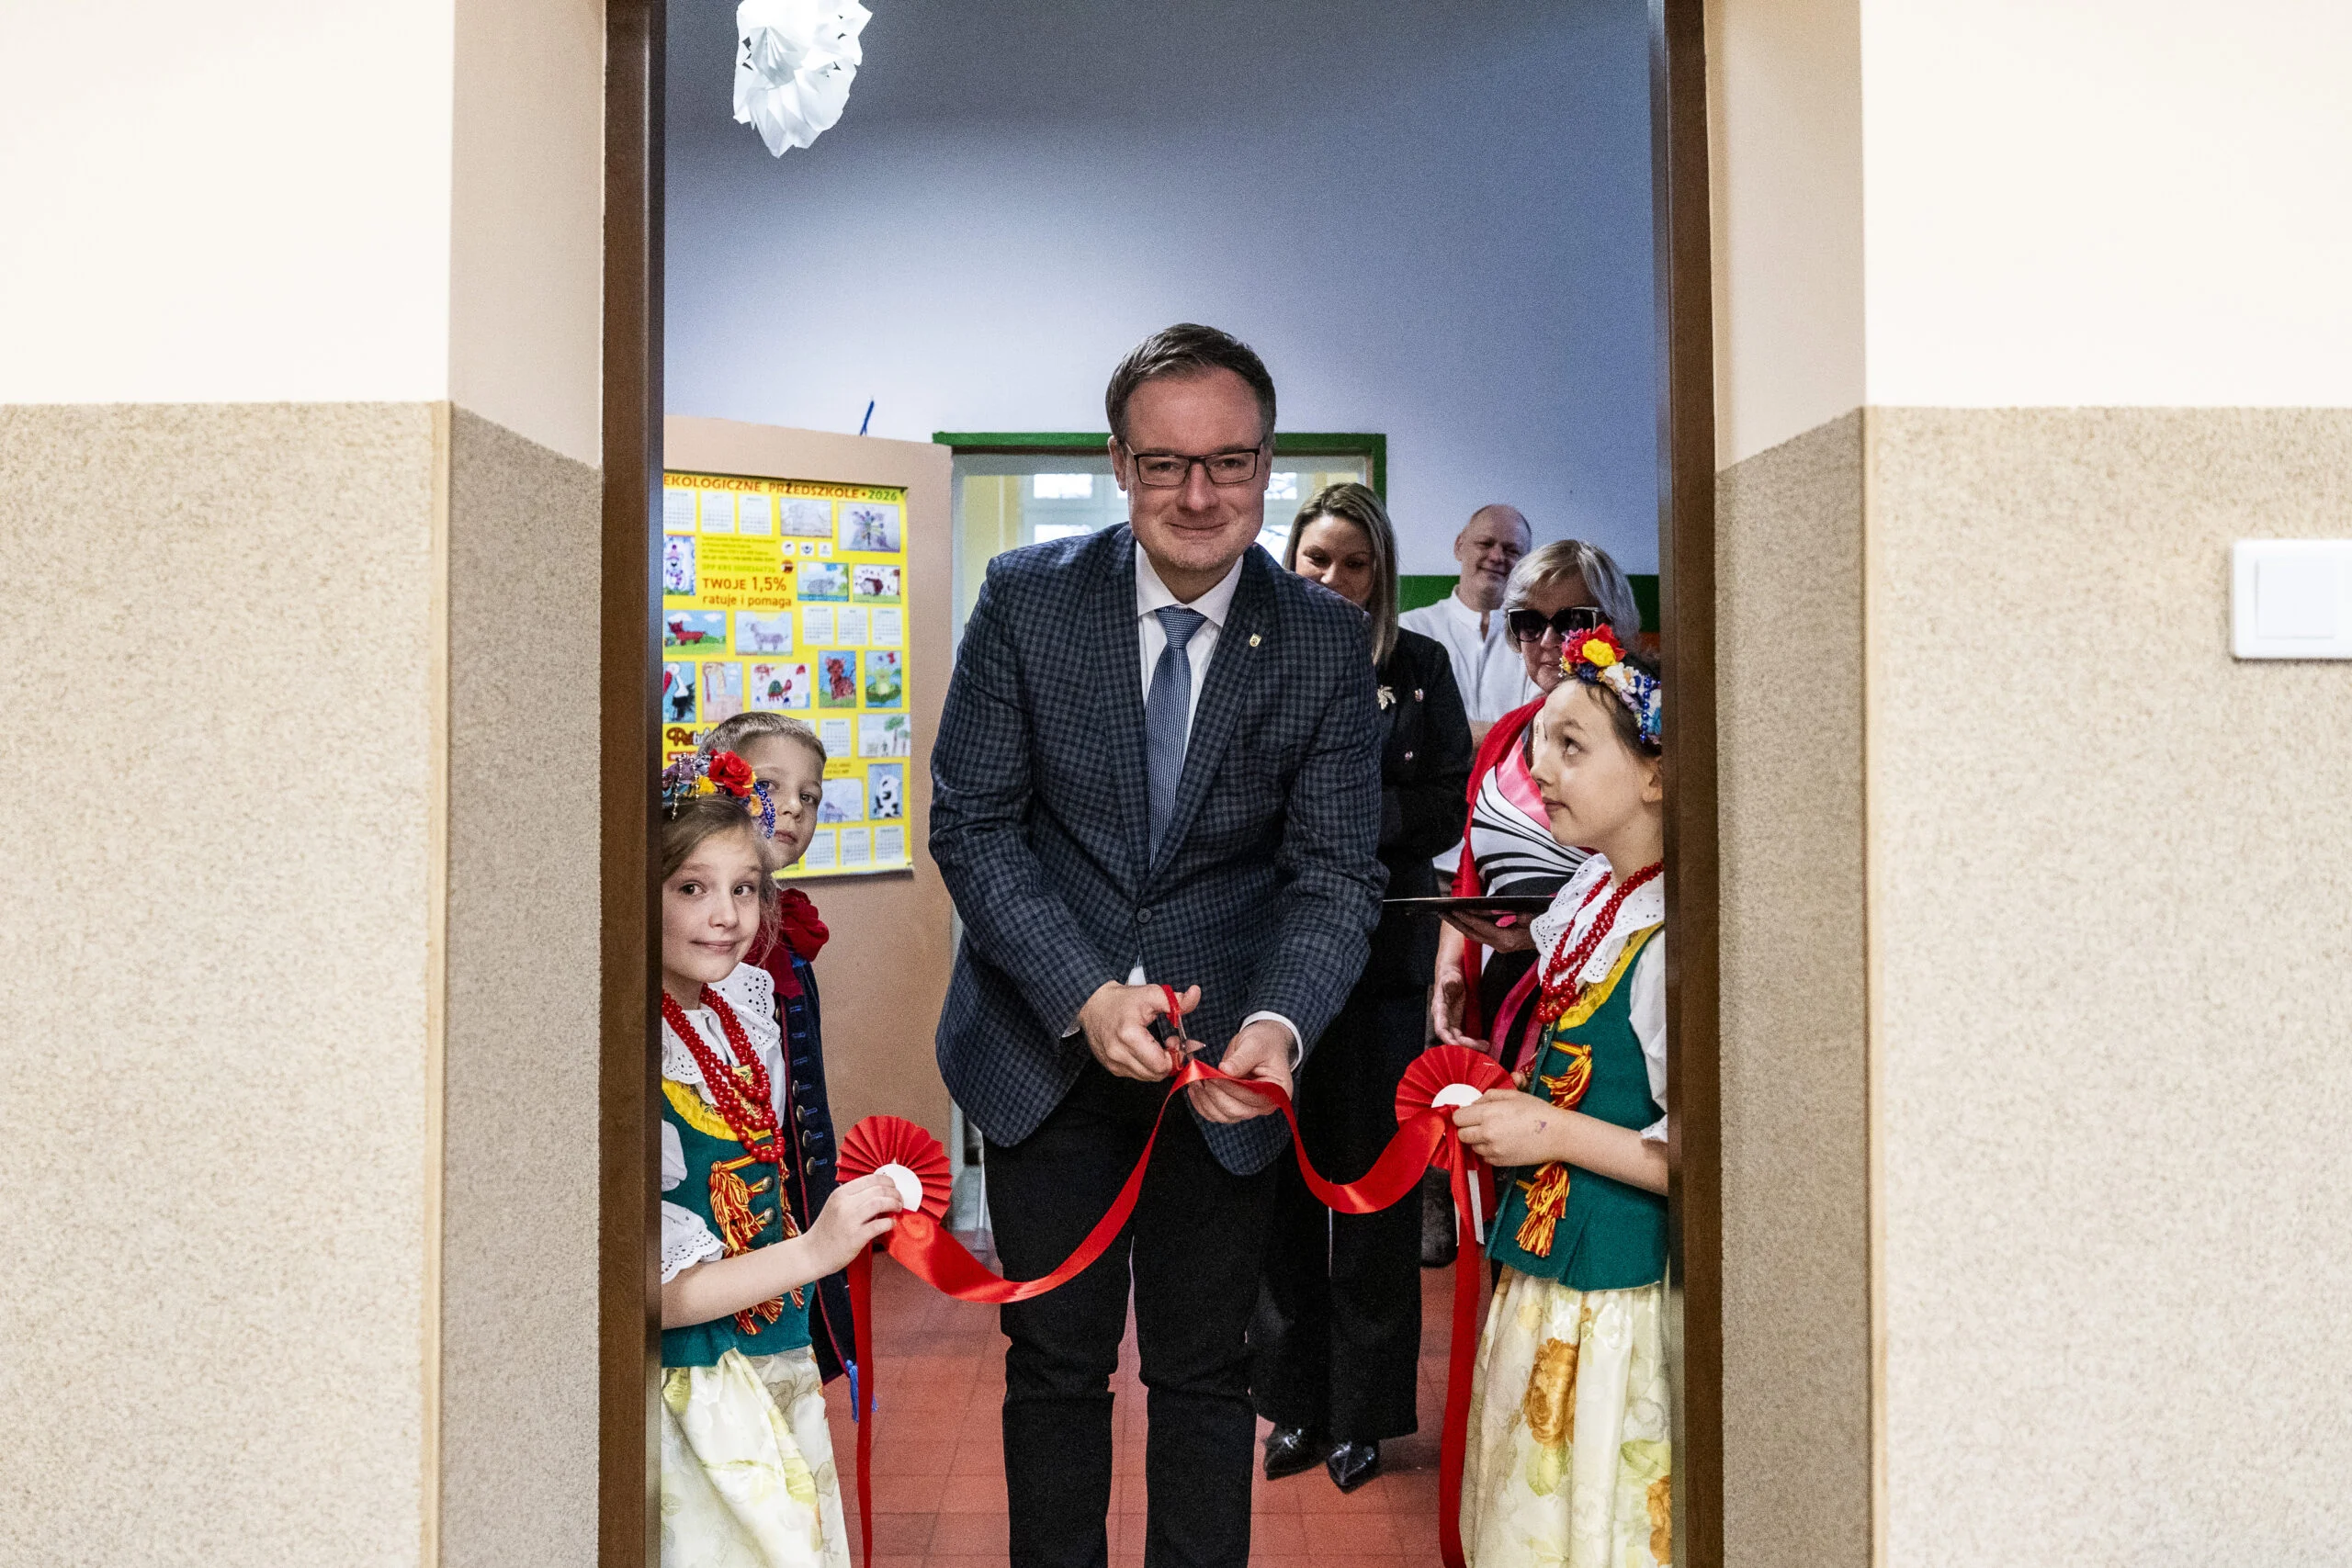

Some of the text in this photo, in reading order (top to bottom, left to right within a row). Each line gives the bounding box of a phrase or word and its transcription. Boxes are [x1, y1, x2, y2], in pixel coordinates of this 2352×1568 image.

[663, 475, 898, 502] EKOLOGICZNE PRZEDSZKOLE 2026
[703, 576, 786, 593] TWOJE 1,5%
[702, 594, 737, 607] ratuje
[747, 596, 792, 609] pomaga
